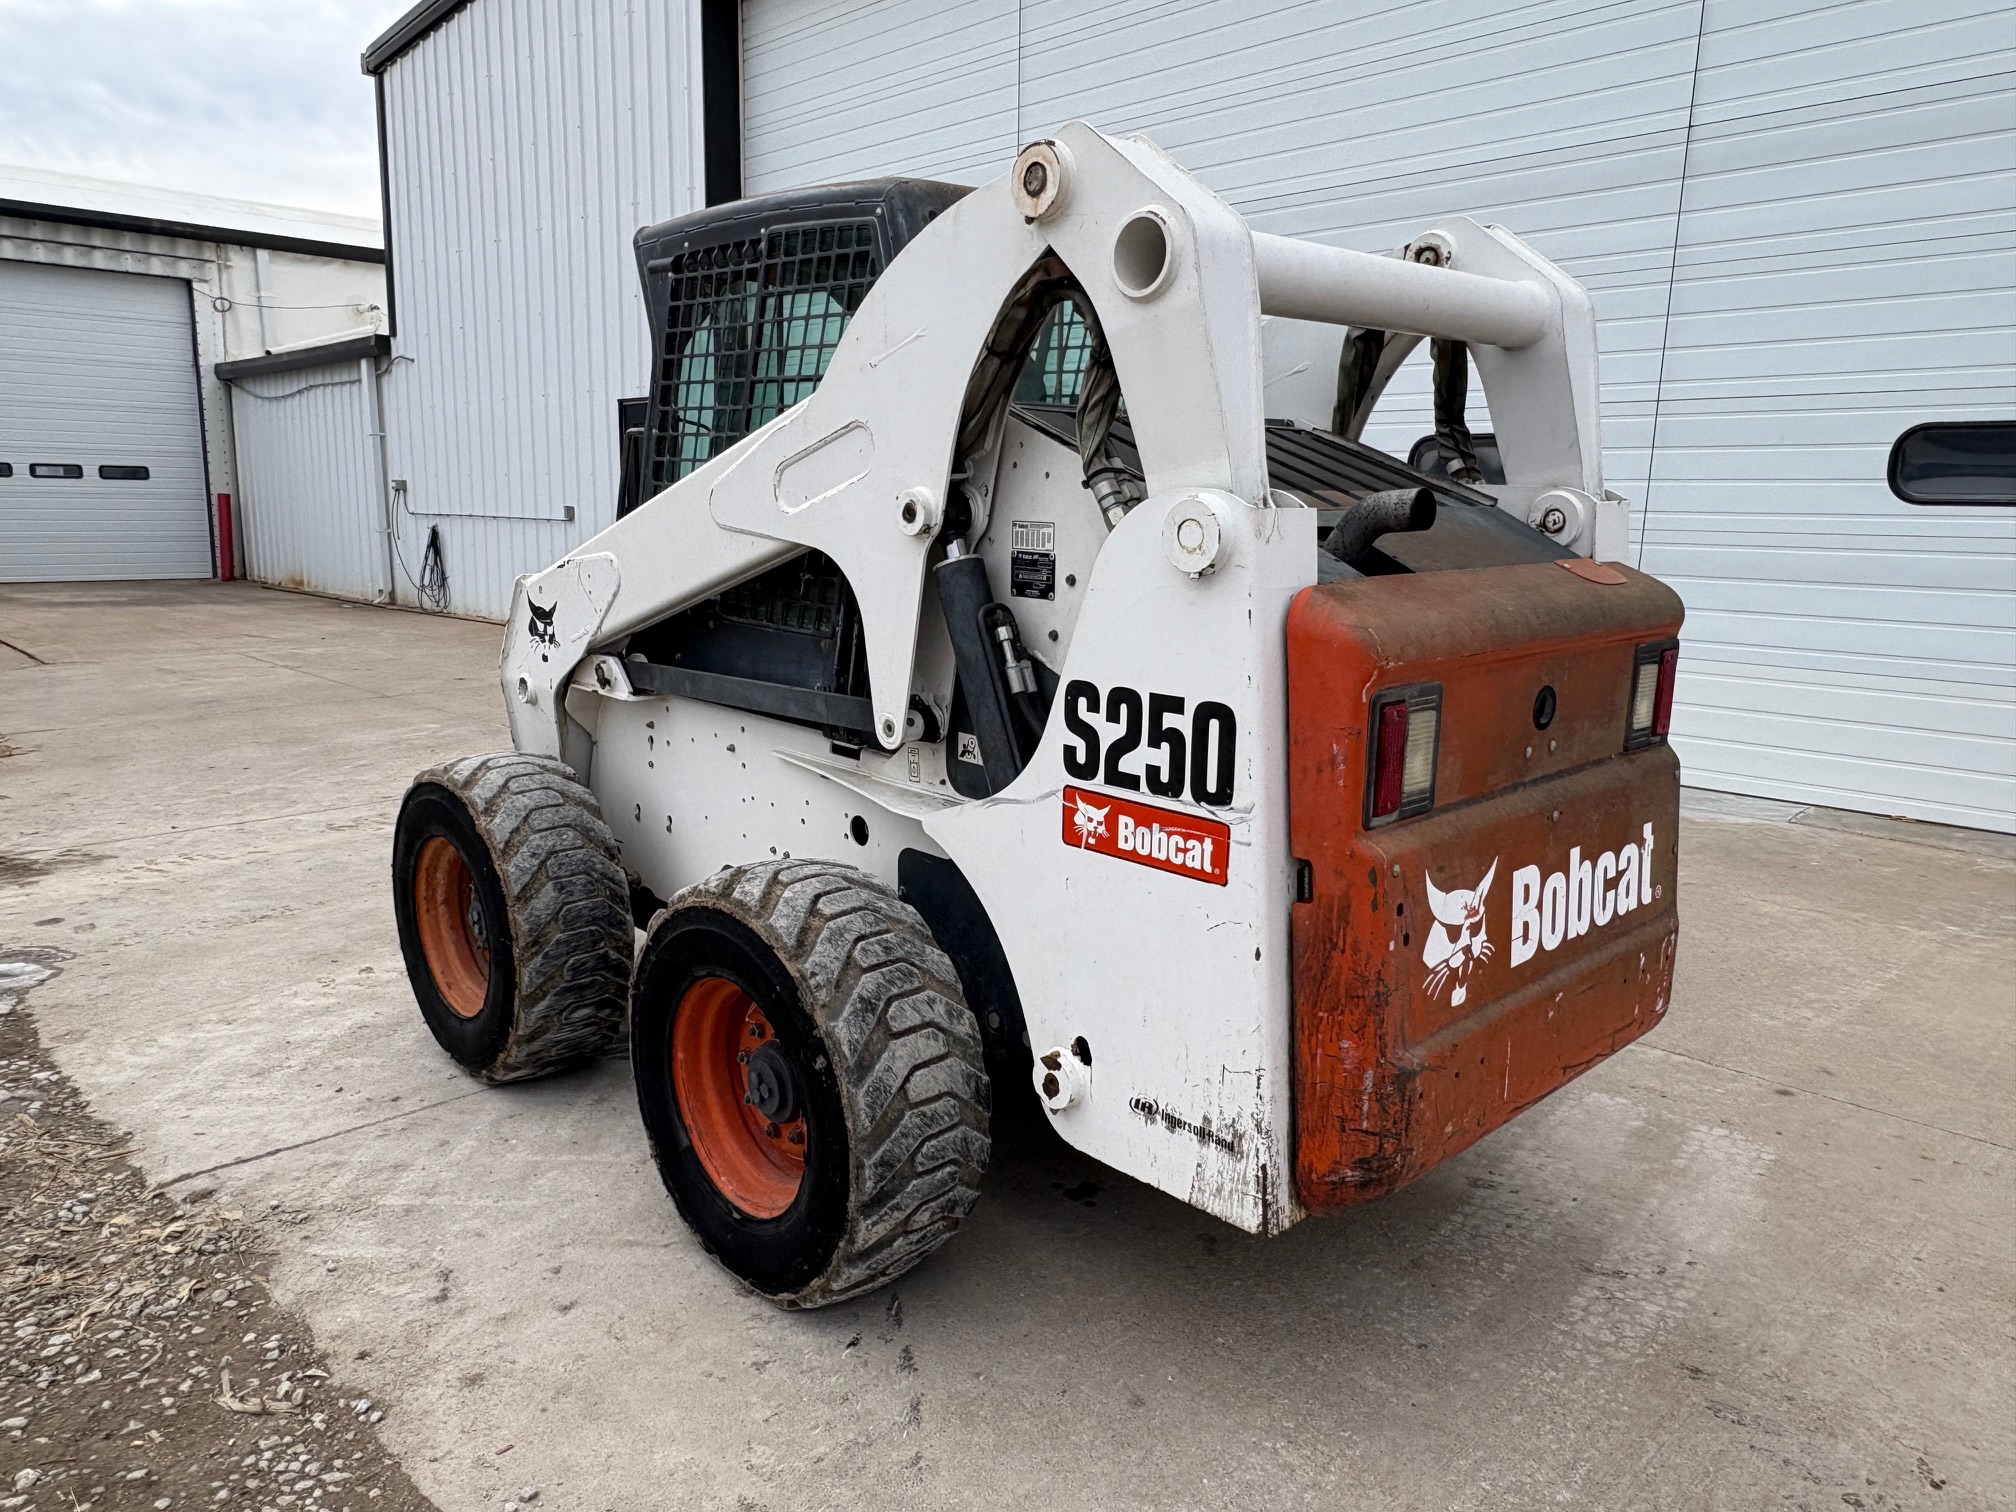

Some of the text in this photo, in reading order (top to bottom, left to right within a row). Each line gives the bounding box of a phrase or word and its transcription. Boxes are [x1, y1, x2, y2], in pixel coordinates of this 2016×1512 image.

[1063, 679, 1237, 806] S250
[1117, 814, 1213, 874] Bobcat
[1510, 821, 1654, 969] Bobcat
